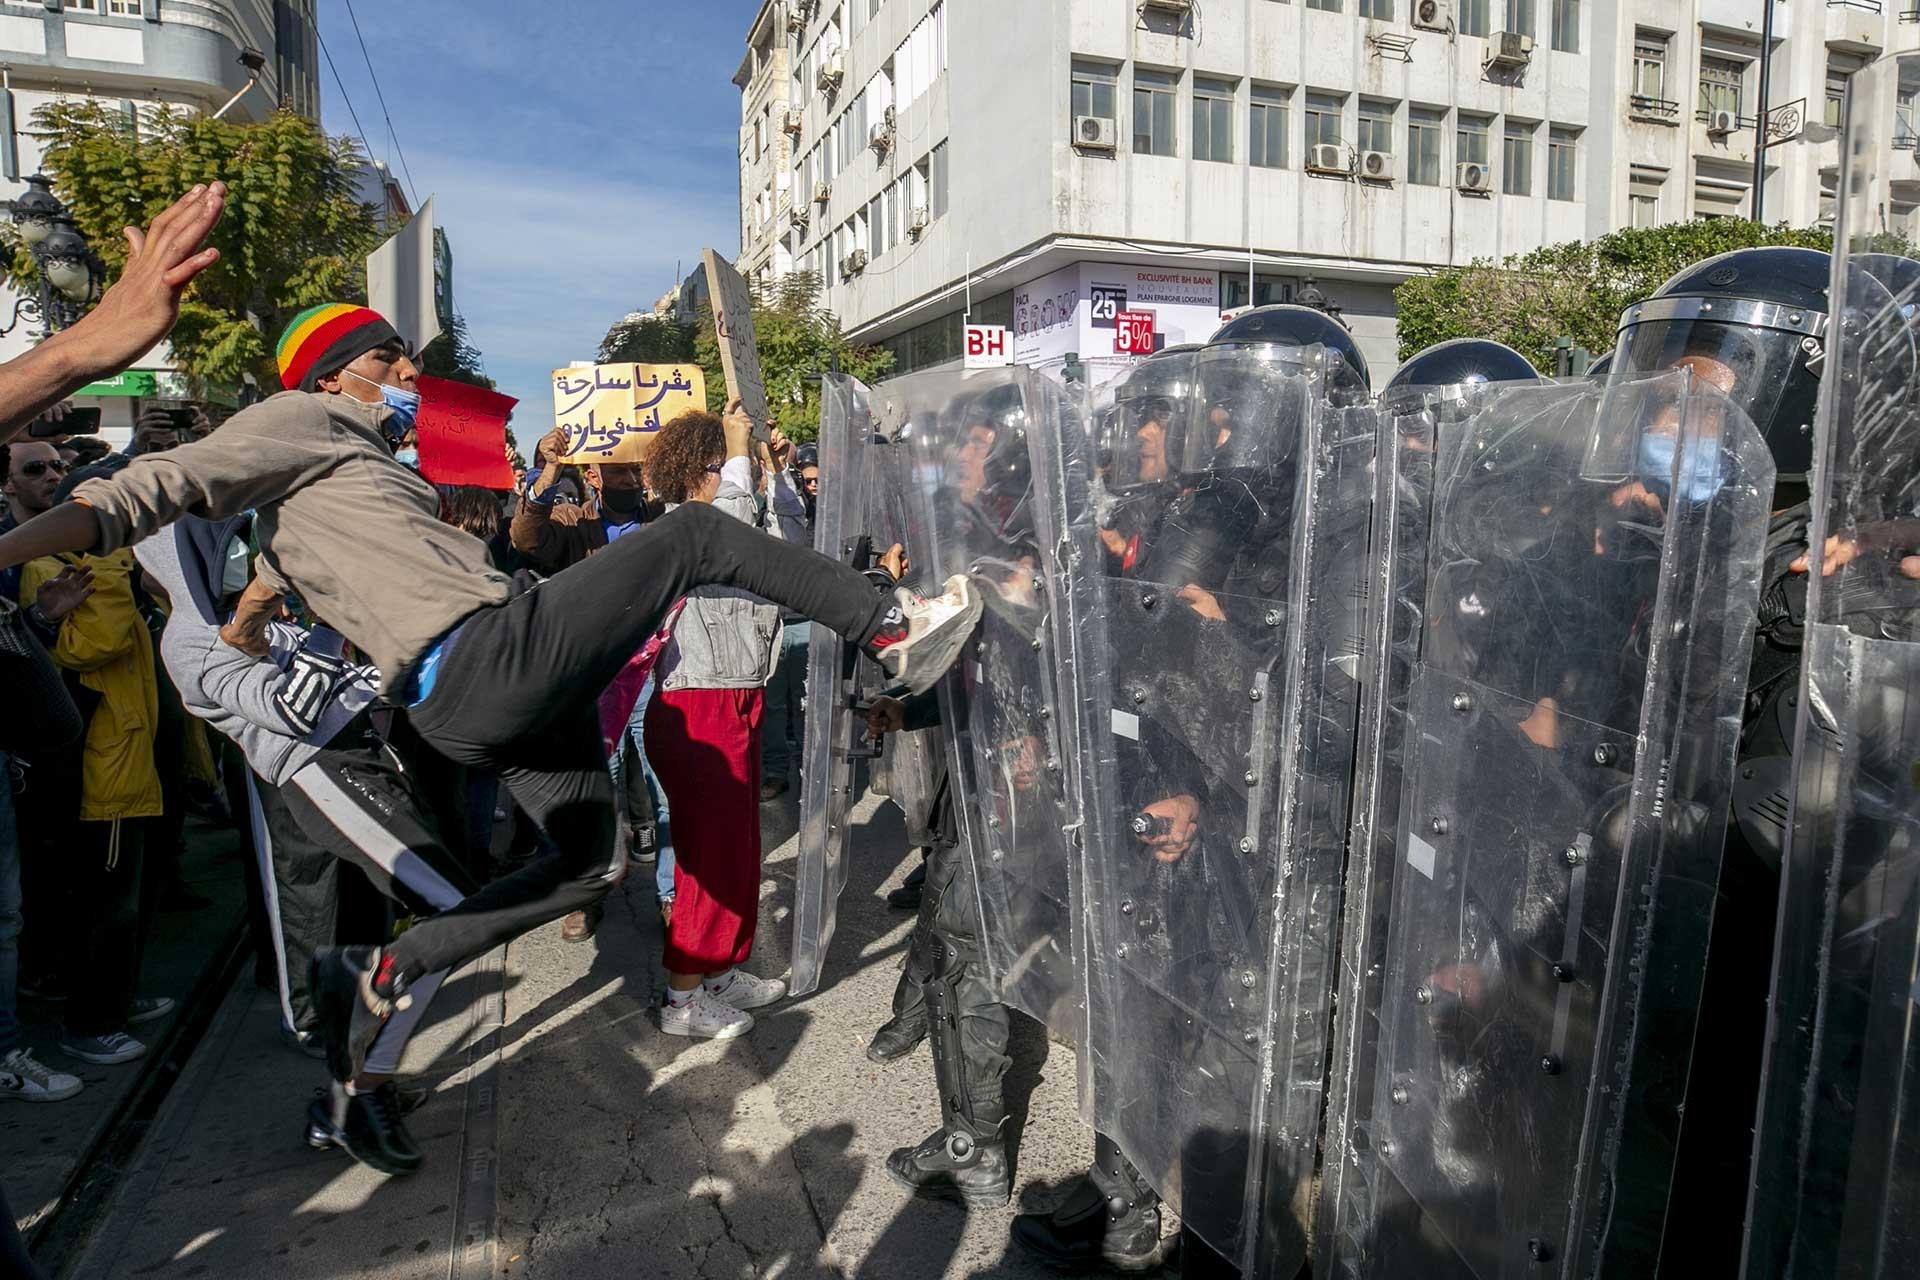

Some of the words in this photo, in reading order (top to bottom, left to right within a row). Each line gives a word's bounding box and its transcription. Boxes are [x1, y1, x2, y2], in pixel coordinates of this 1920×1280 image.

[1182, 275, 1192, 284] BH
[1193, 276, 1213, 285] BANK
[1092, 290, 1116, 319] 25
[1137, 293, 1153, 301] PLAN
[1154, 294, 1181, 302] EPARGNE
[1182, 296, 1213, 304] LOGEMENT
[1016, 290, 1077, 341] GROW
[967, 329, 1004, 356] BH
[1118, 321, 1151, 350] 5%
[557, 367, 632, 416] سارحة
[562, 408, 607, 458] باردو
[584, 417, 625, 457] في
